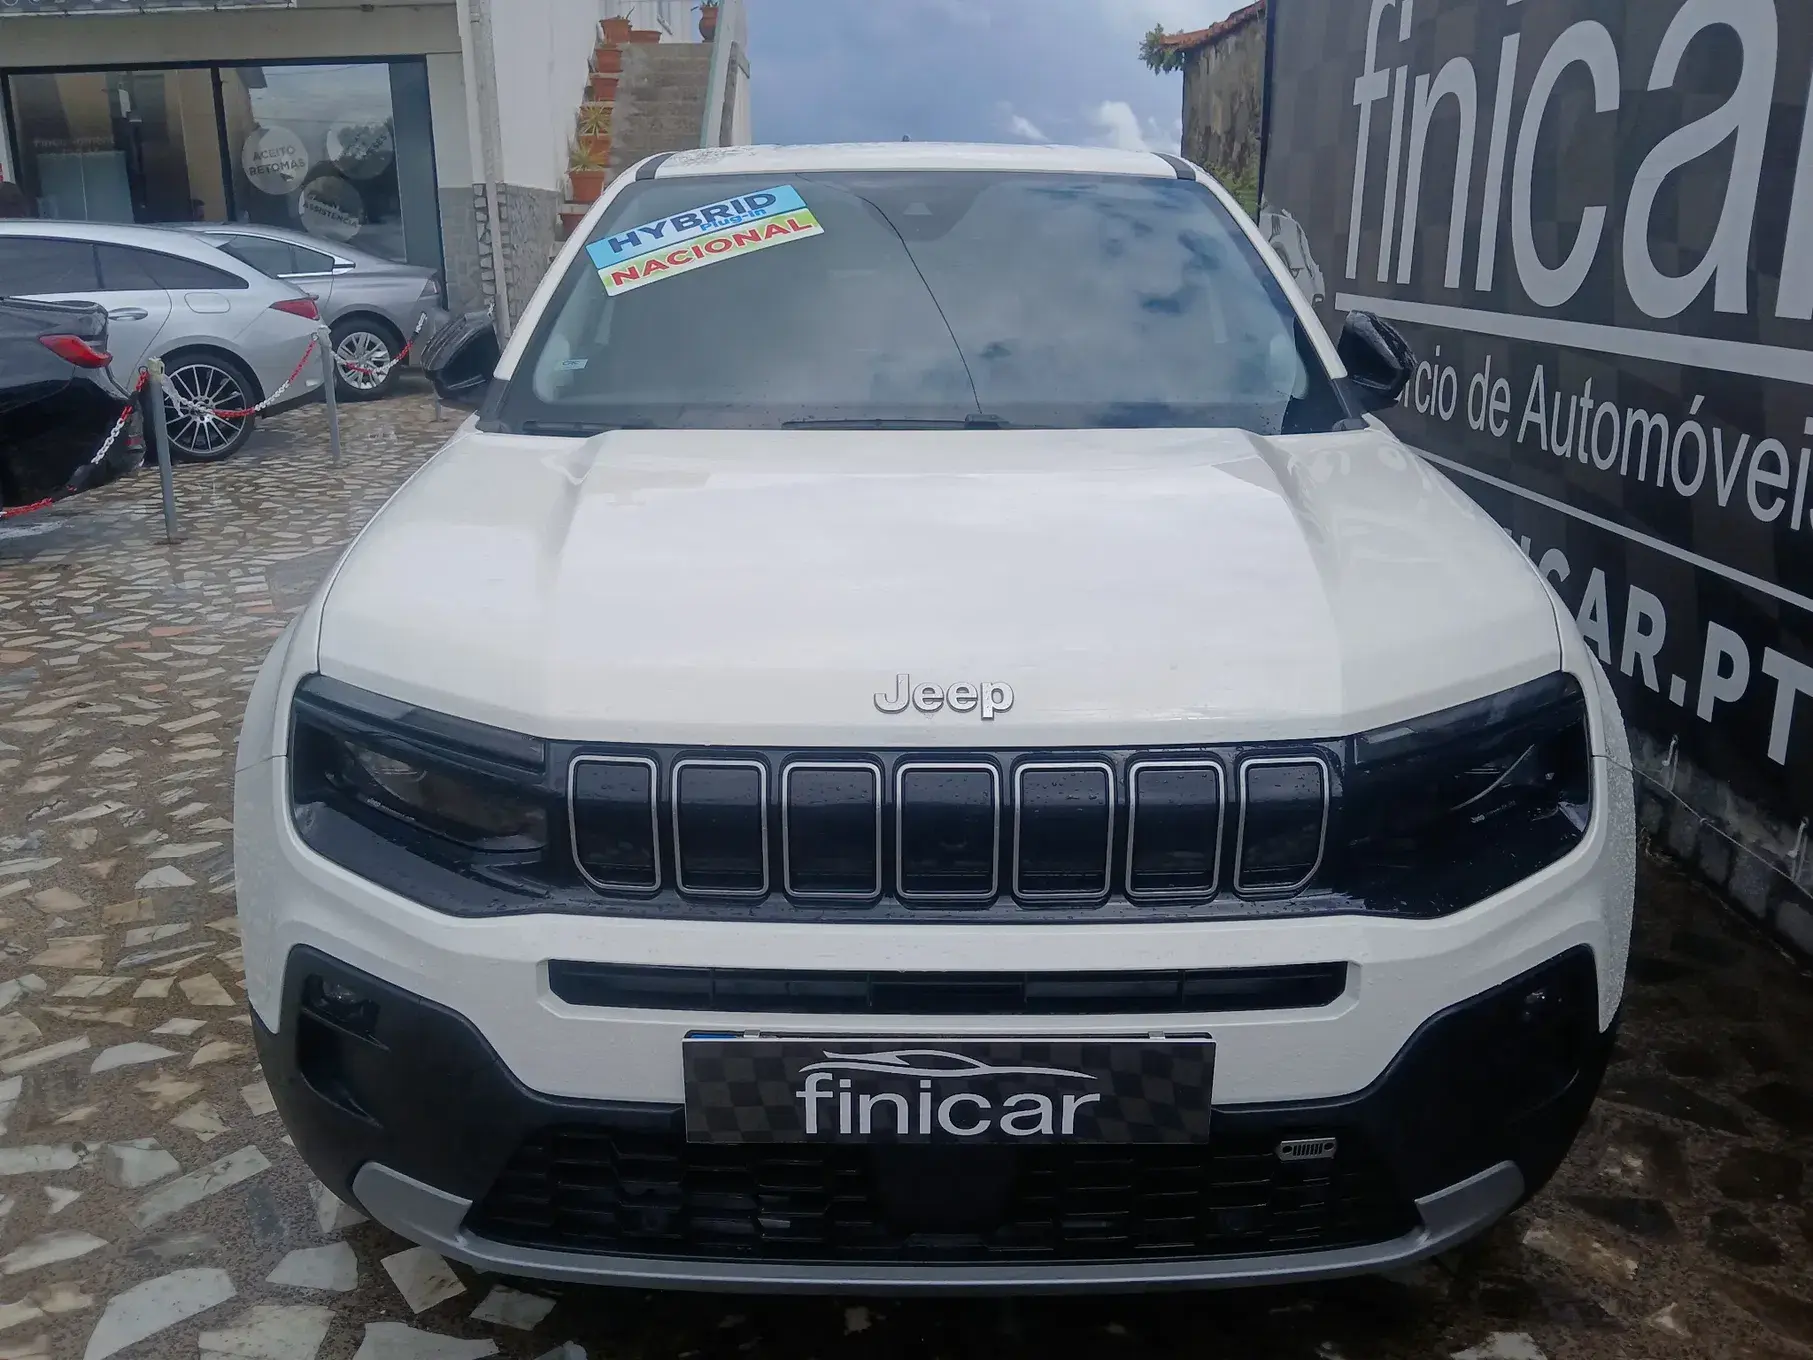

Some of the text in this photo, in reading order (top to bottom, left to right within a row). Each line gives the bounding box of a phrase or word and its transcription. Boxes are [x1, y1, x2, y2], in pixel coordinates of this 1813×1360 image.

[249, 158, 305, 176] RETOMAS
[253, 145, 296, 161] ACEITO
[608, 193, 776, 254] HYBRID
[700, 208, 767, 231] Plug-in
[611, 218, 812, 286] NACIONAL
[1467, 355, 1511, 437] de
[1516, 364, 1813, 532] Automóvei
[873, 673, 1014, 721] Jeep
[796, 1072, 1101, 1136] finicar
